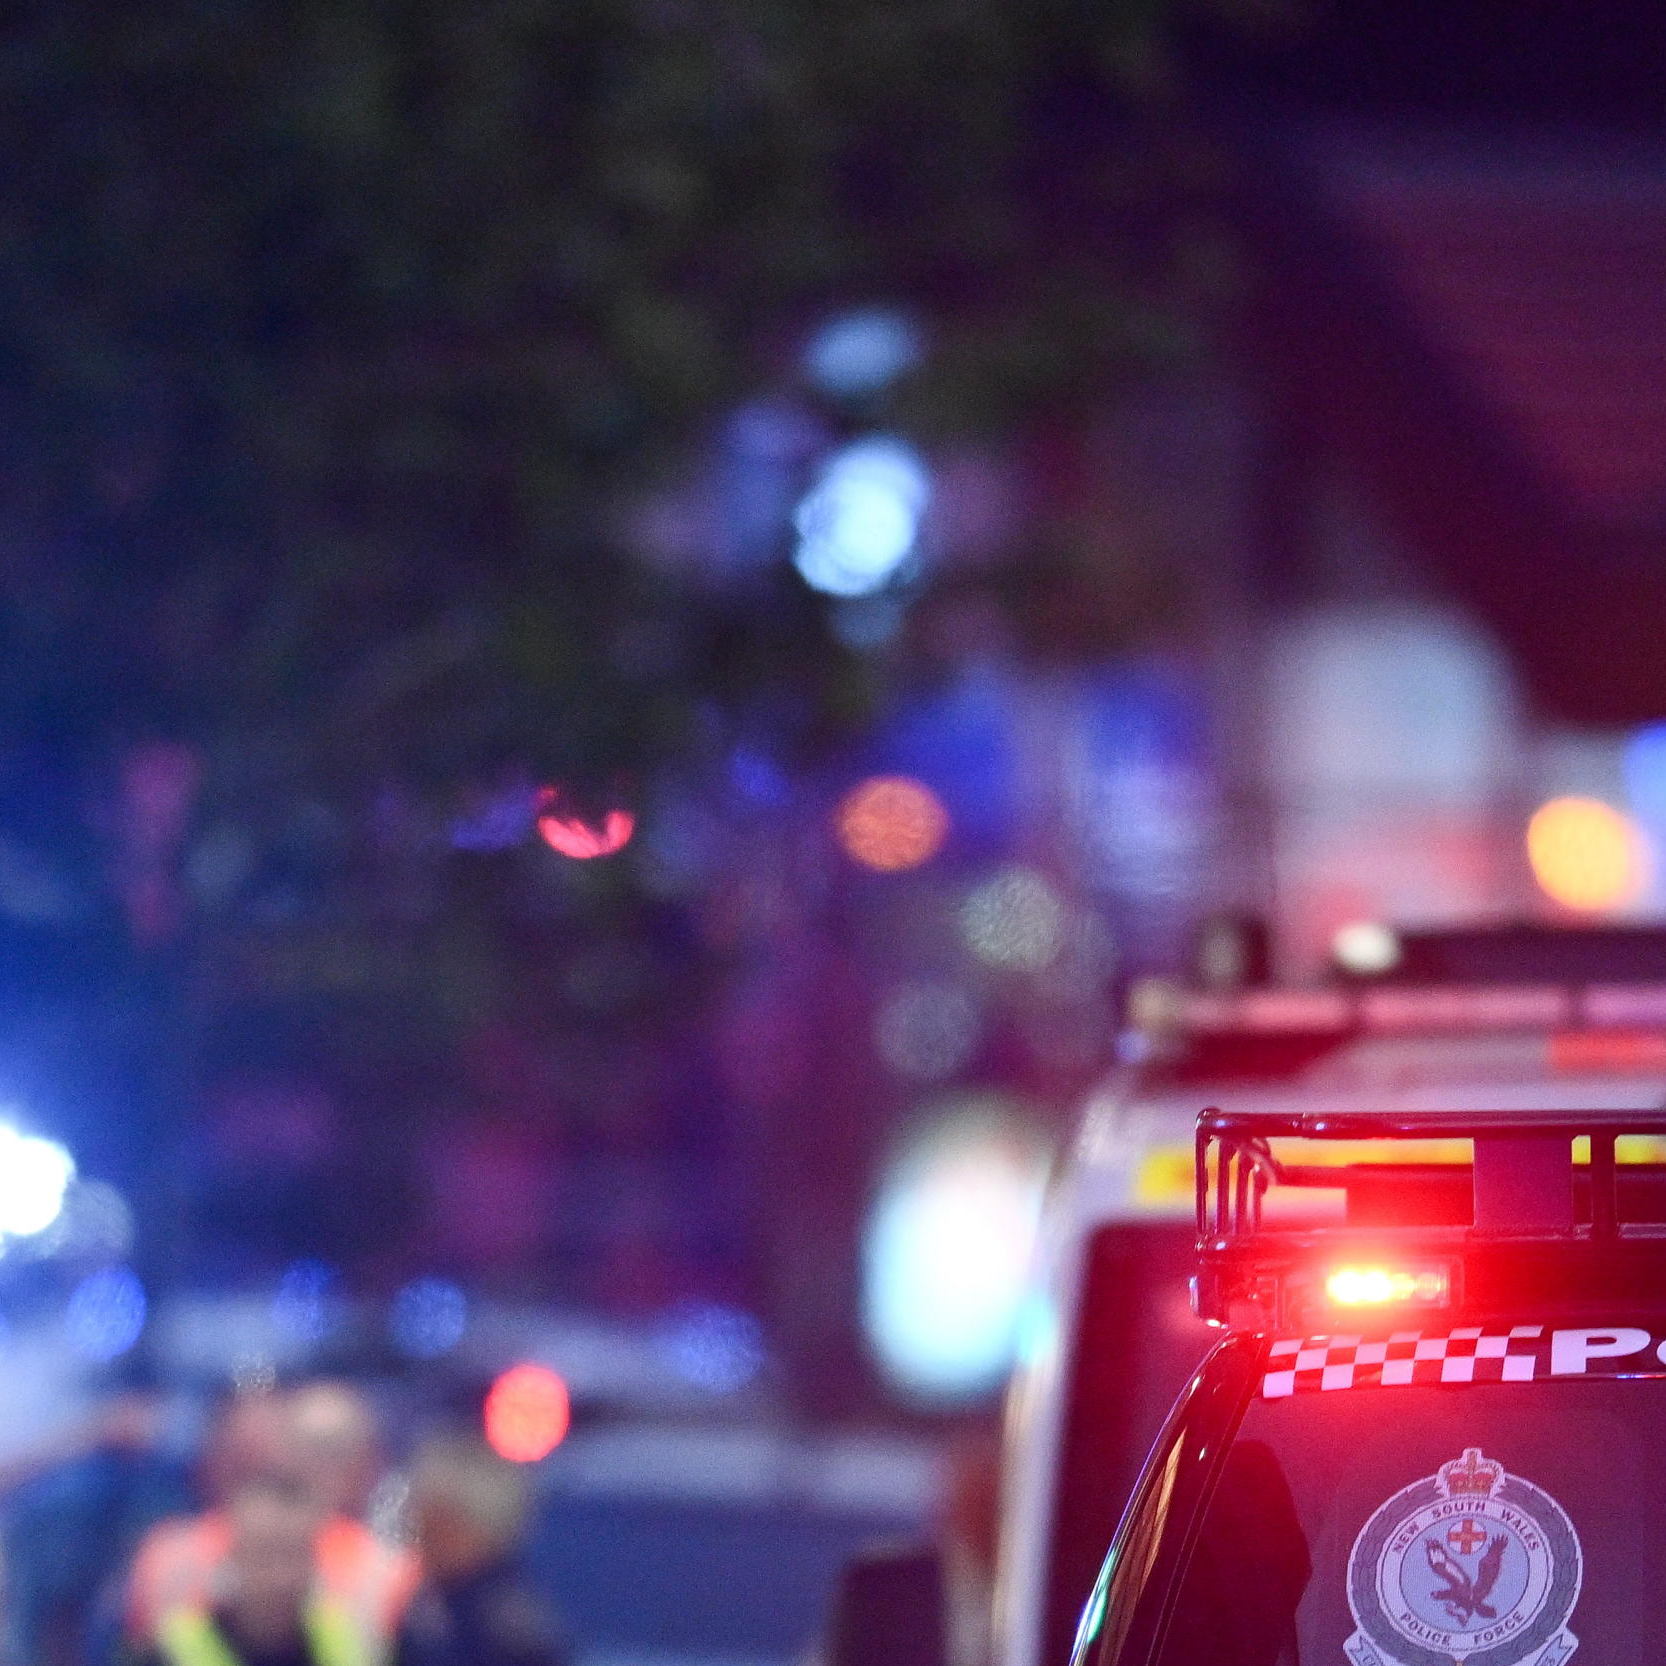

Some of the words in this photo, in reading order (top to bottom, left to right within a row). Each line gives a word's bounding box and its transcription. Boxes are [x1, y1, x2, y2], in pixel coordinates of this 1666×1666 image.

[1395, 1522, 1421, 1552] NEW
[1432, 1501, 1486, 1518] SOUTH
[1501, 1509, 1540, 1550] WALES
[1400, 1612, 1451, 1646] POLICE
[1473, 1611, 1525, 1645] FORCE
